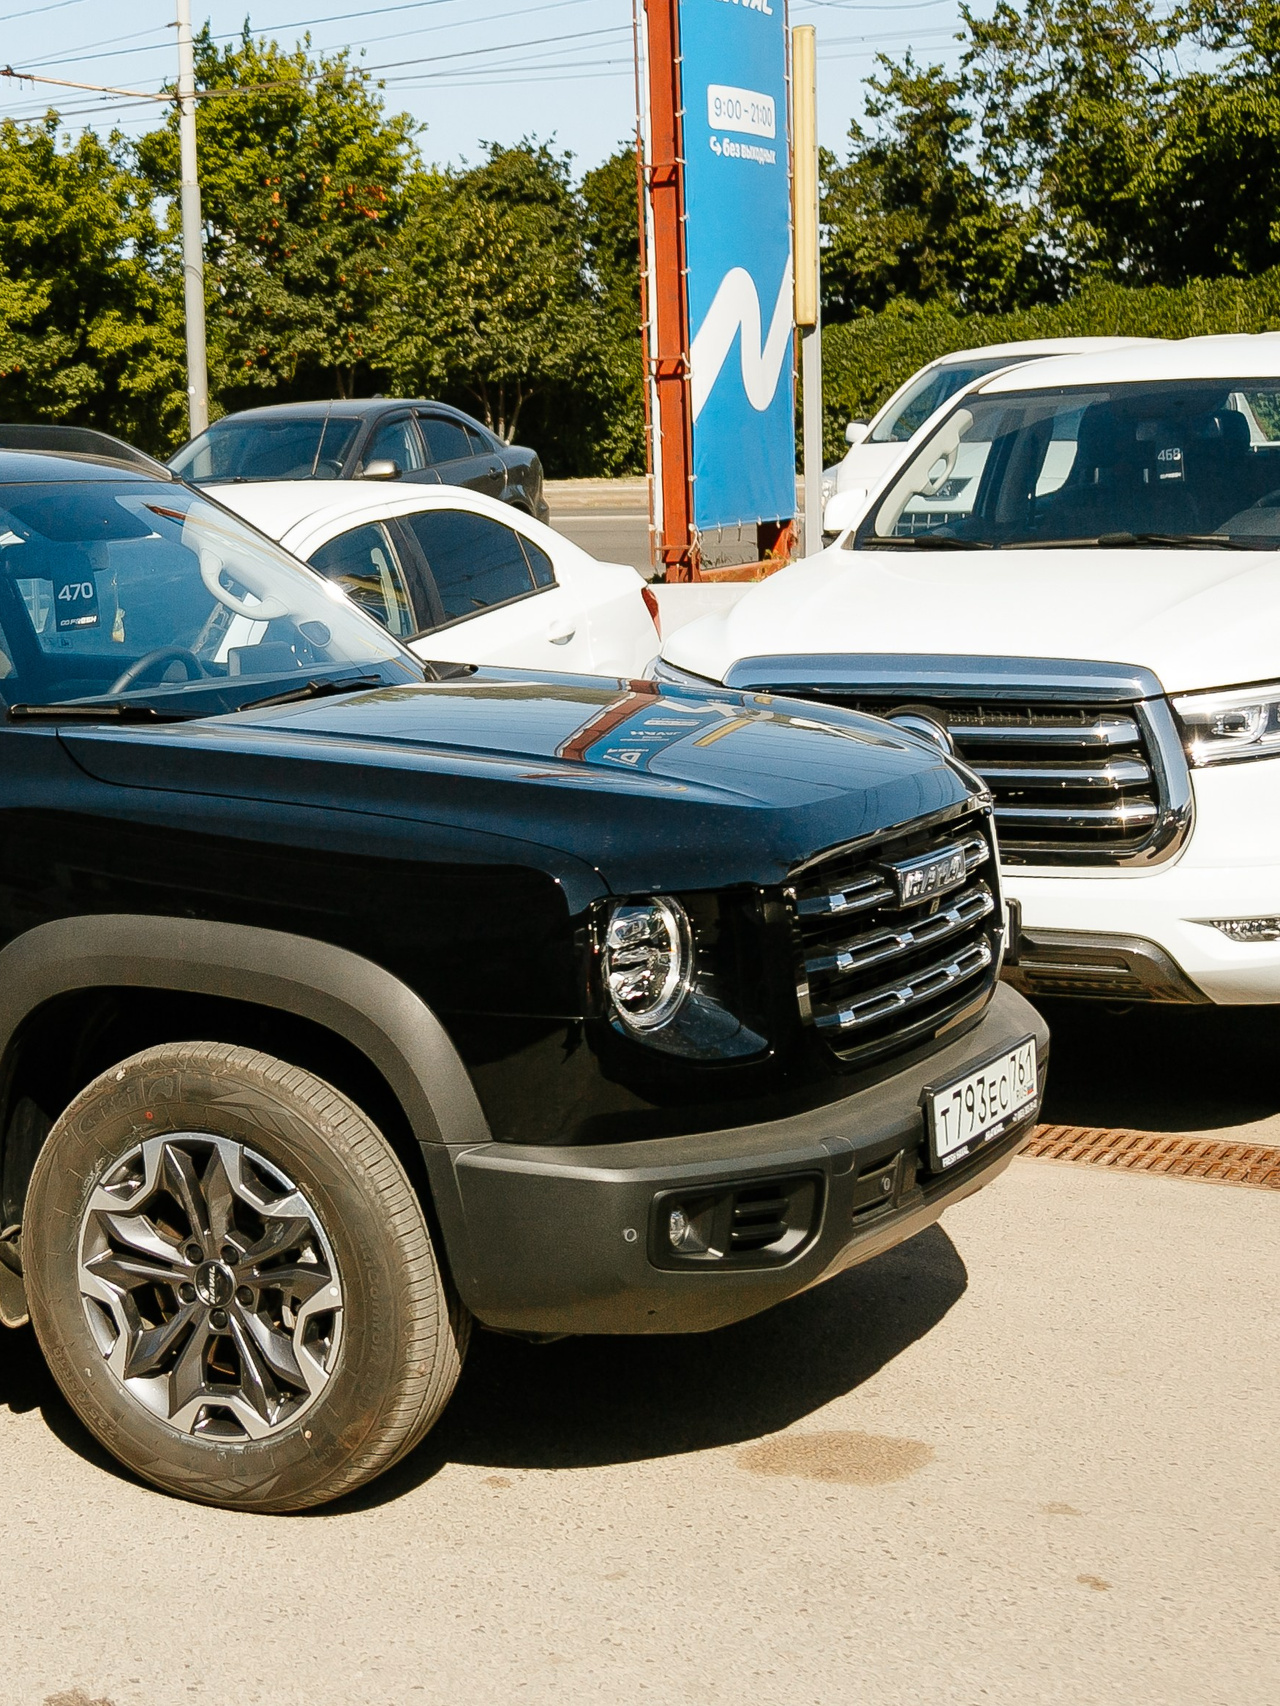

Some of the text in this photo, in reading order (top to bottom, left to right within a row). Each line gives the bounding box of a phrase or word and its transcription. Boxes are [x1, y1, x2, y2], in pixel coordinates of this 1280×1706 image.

[714, 97, 741, 120] 9:00
[751, 103, 773, 127] 21:00
[722, 137, 740, 158] без
[58, 582, 94, 601] 470
[1010, 1044, 1033, 1092] 761
